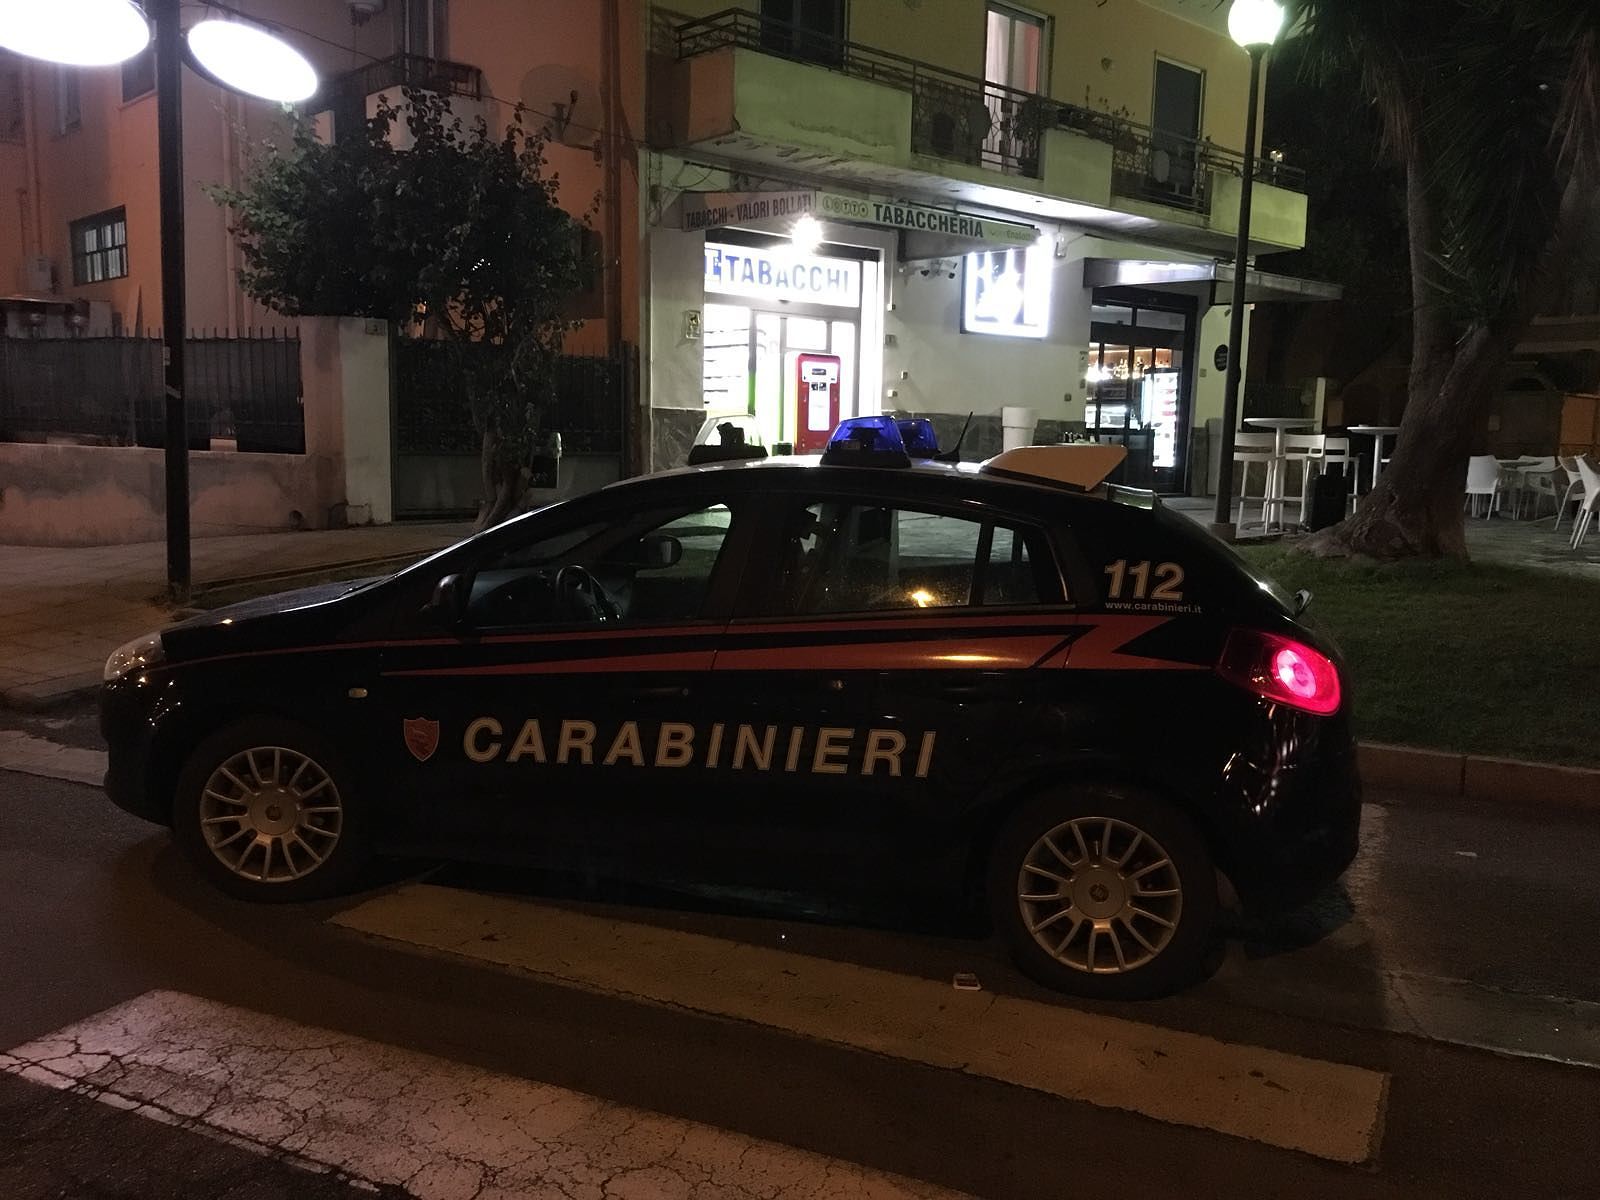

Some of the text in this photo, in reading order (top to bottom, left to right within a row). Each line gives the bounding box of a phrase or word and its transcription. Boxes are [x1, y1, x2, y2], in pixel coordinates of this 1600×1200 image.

[686, 207, 728, 229] TABACCHI
[737, 199, 769, 222] VALORI
[823, 195, 869, 218] LOTTO
[873, 203, 984, 238] TABACCHERIA
[725, 255, 849, 292] TABACCHI
[1104, 559, 1185, 601] 112
[1104, 602, 1202, 613] www.carabinieri.it
[463, 716, 937, 778] CARABINIERI
